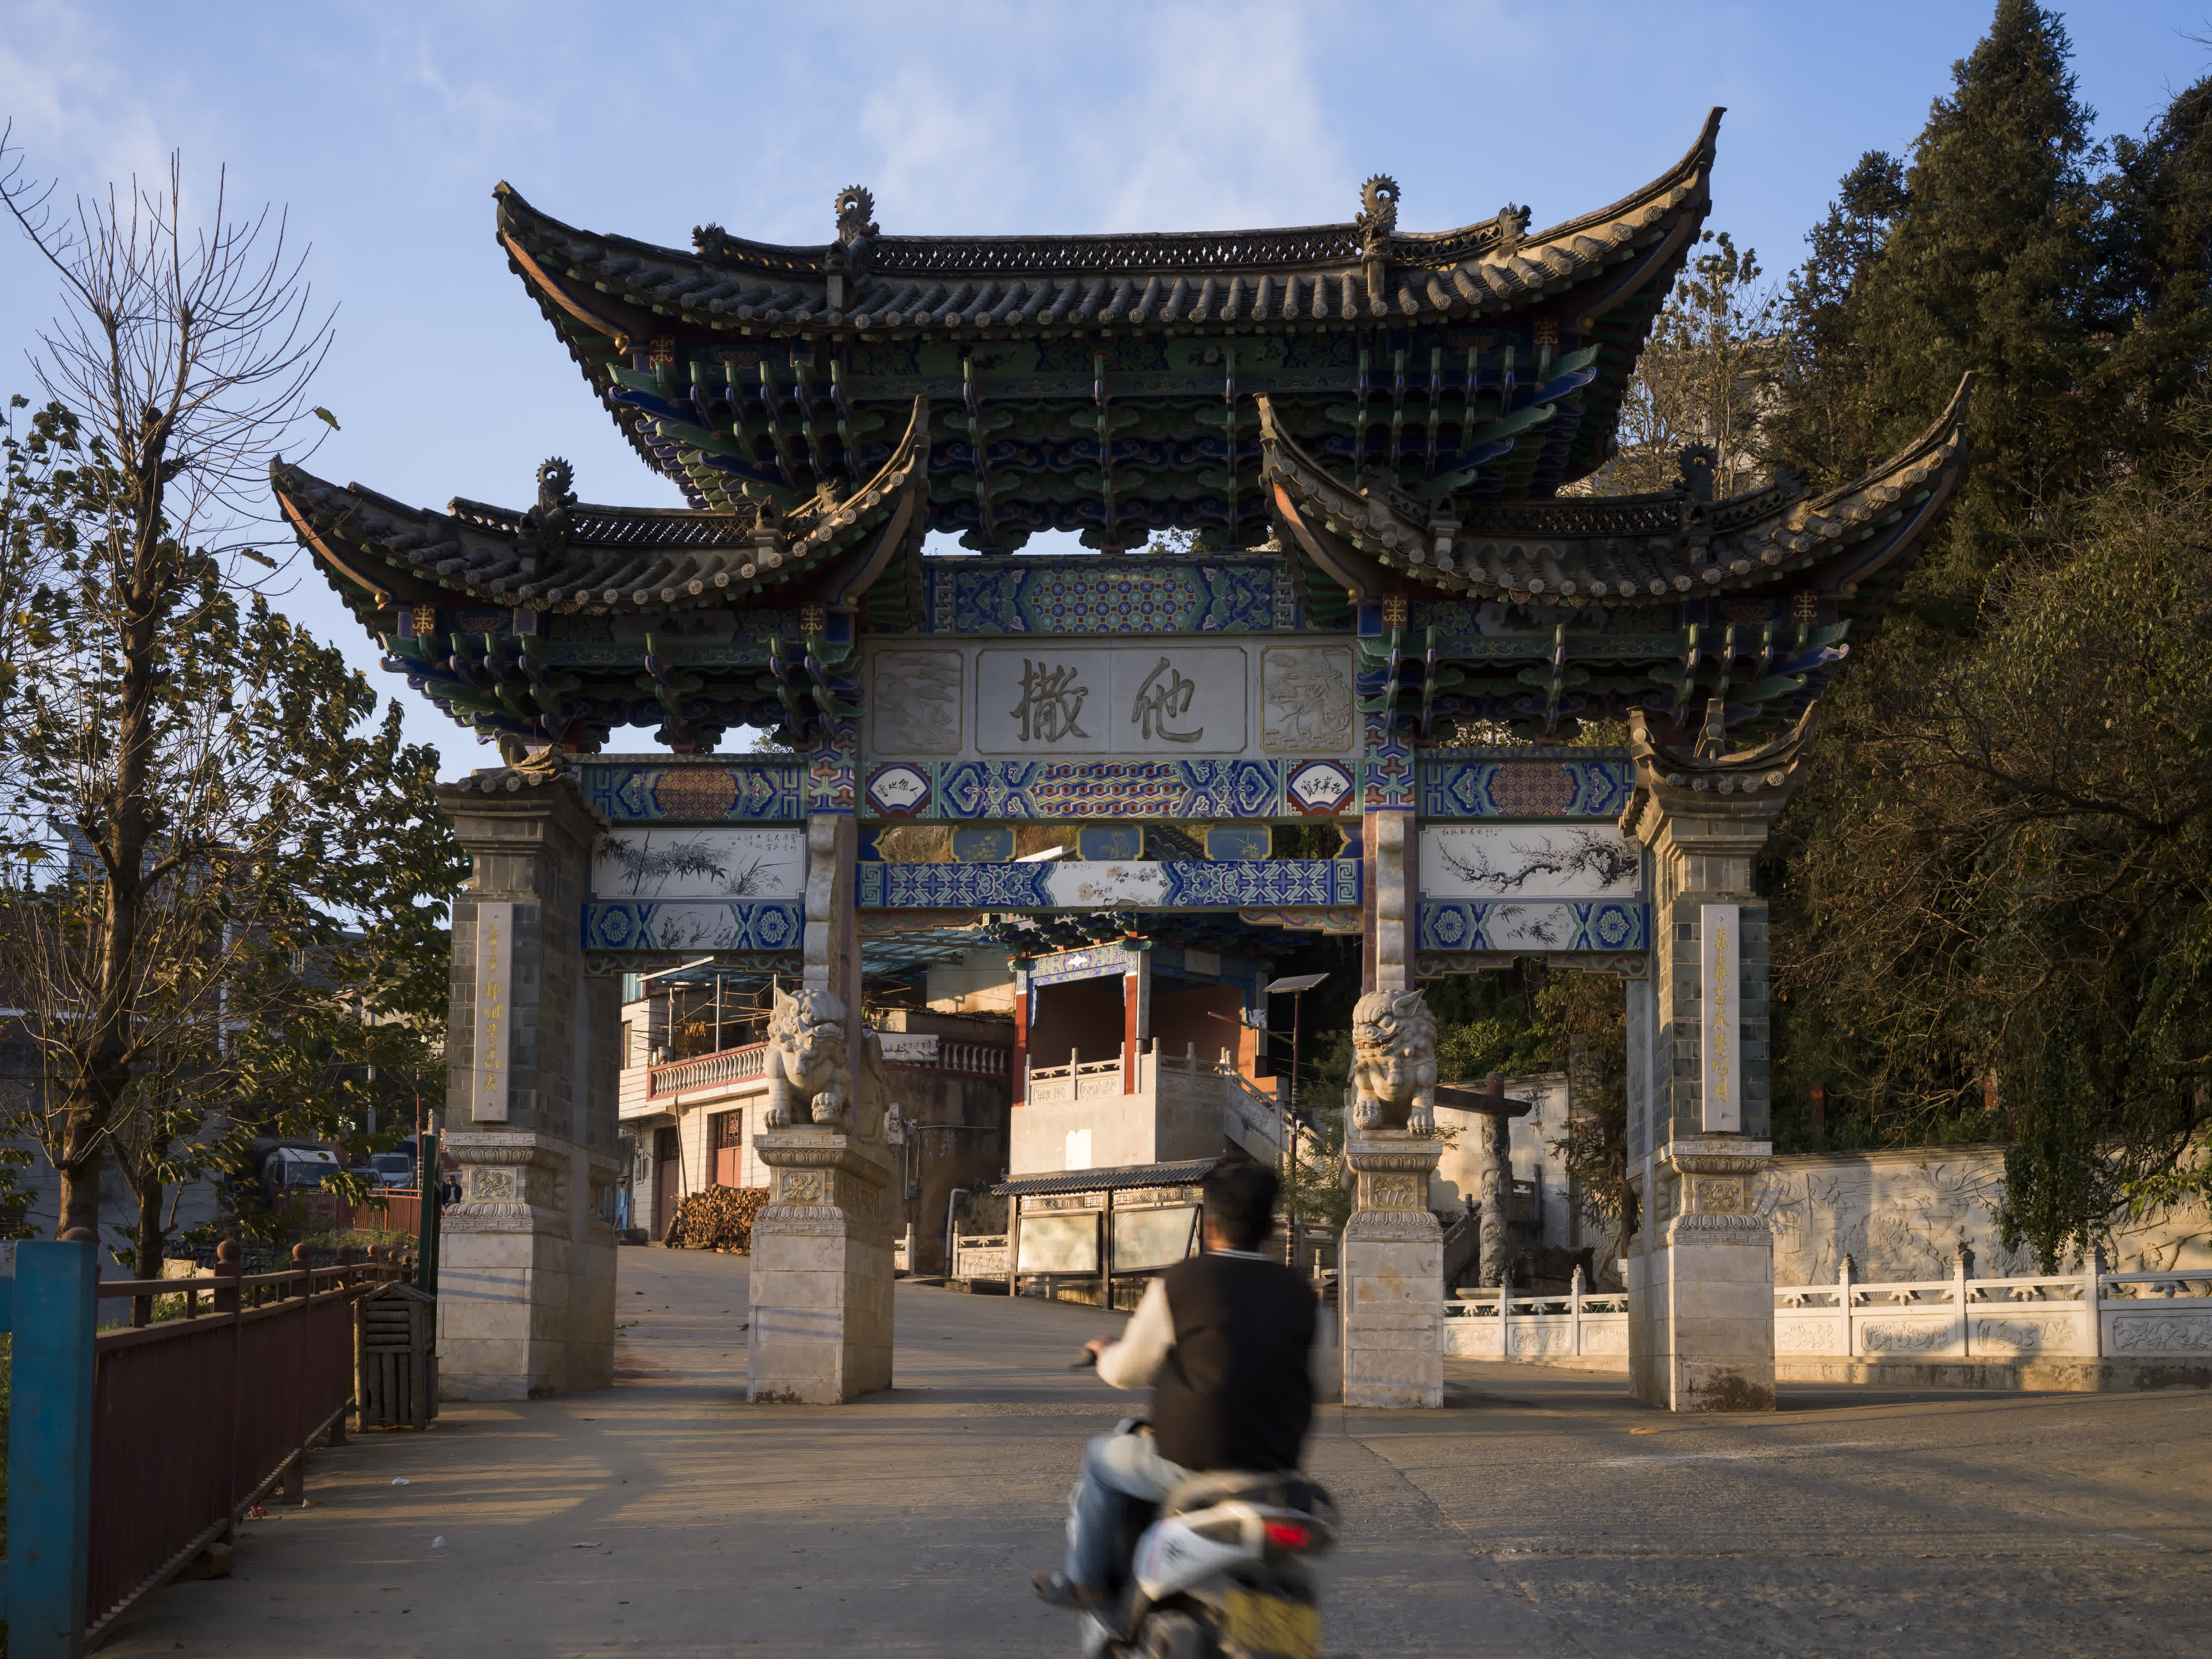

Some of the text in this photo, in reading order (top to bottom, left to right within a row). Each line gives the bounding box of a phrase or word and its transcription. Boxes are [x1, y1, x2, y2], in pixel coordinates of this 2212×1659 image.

[1136, 1191, 1177, 1202] 文化宣传栏
[1042, 1197, 1079, 1208] 文化宣传栏
